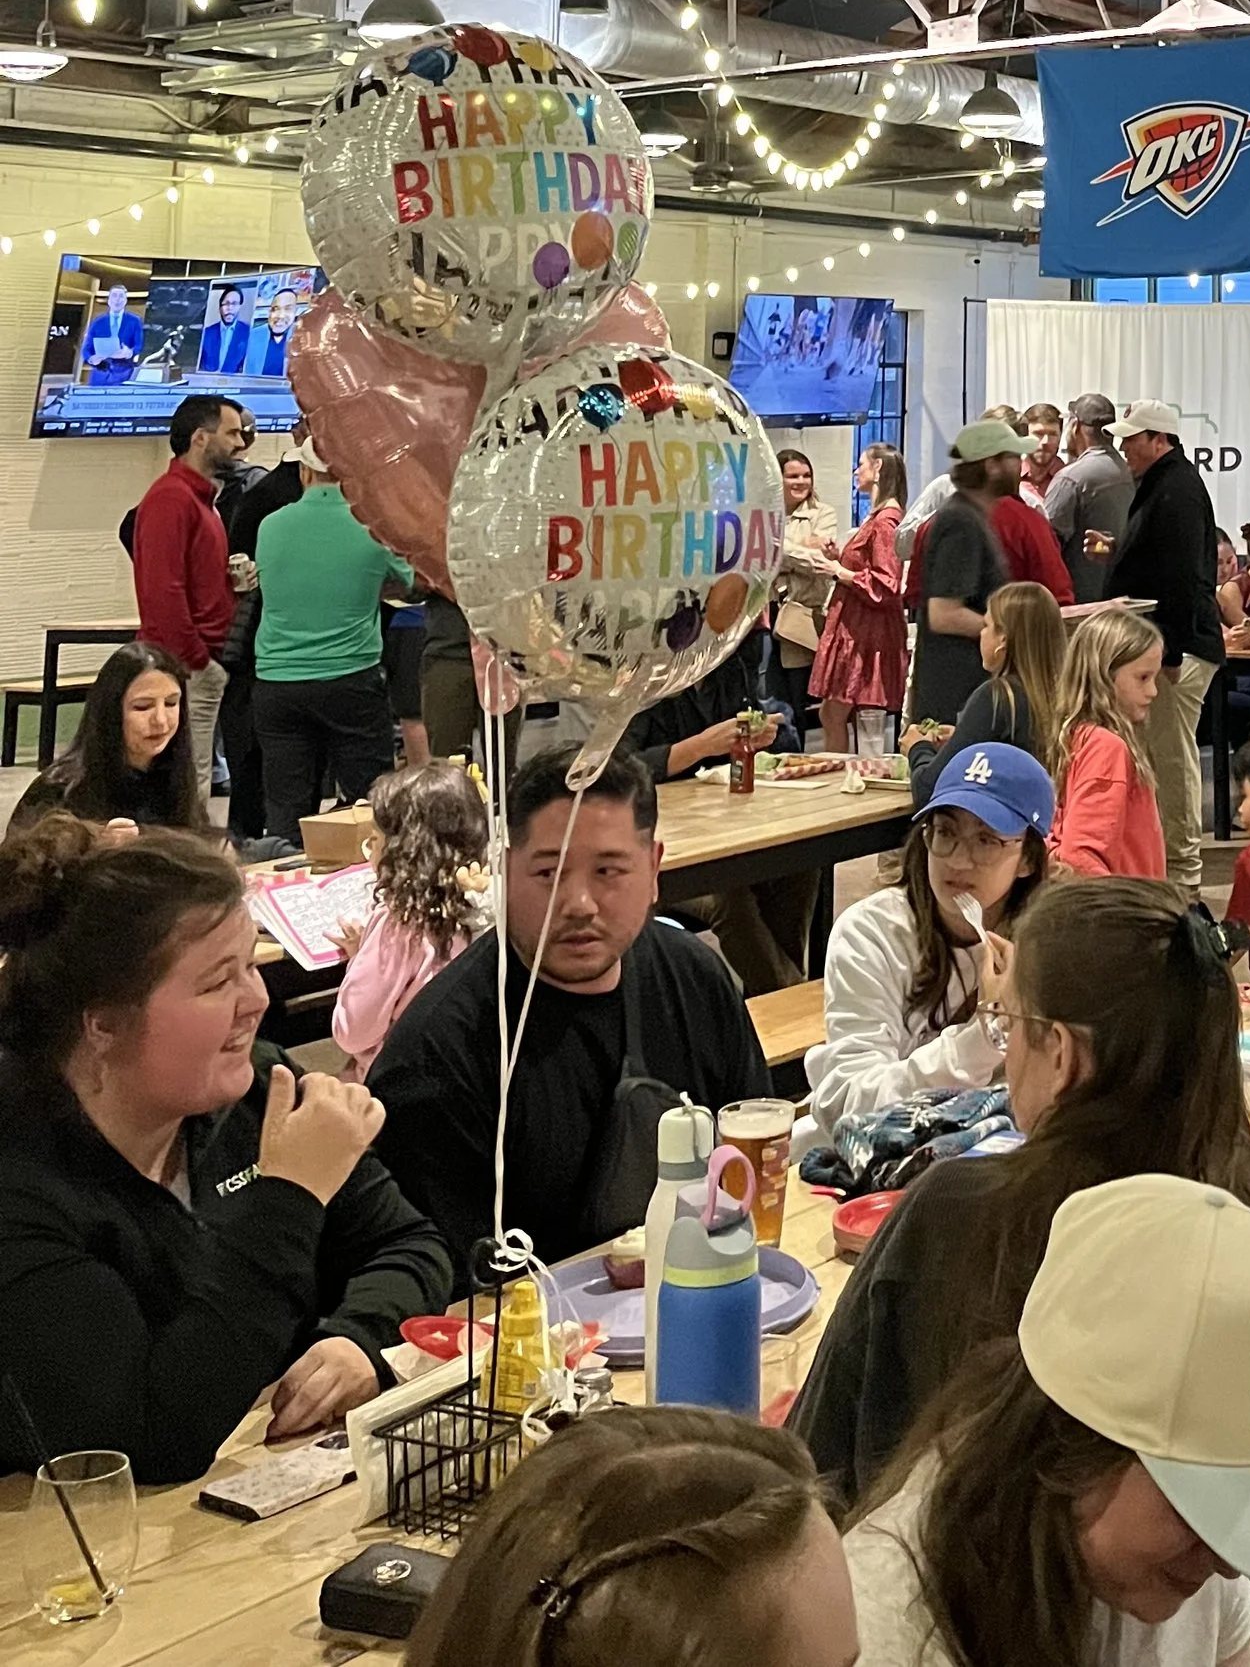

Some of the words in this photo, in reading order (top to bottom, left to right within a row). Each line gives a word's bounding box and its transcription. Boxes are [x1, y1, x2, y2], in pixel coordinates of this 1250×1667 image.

[418, 89, 597, 151] HAPPY
[1128, 120, 1220, 196] OKC
[579, 440, 748, 508] HAPPY
[546, 509, 781, 583] BIRTHDAY
[963, 752, 993, 784] LA
